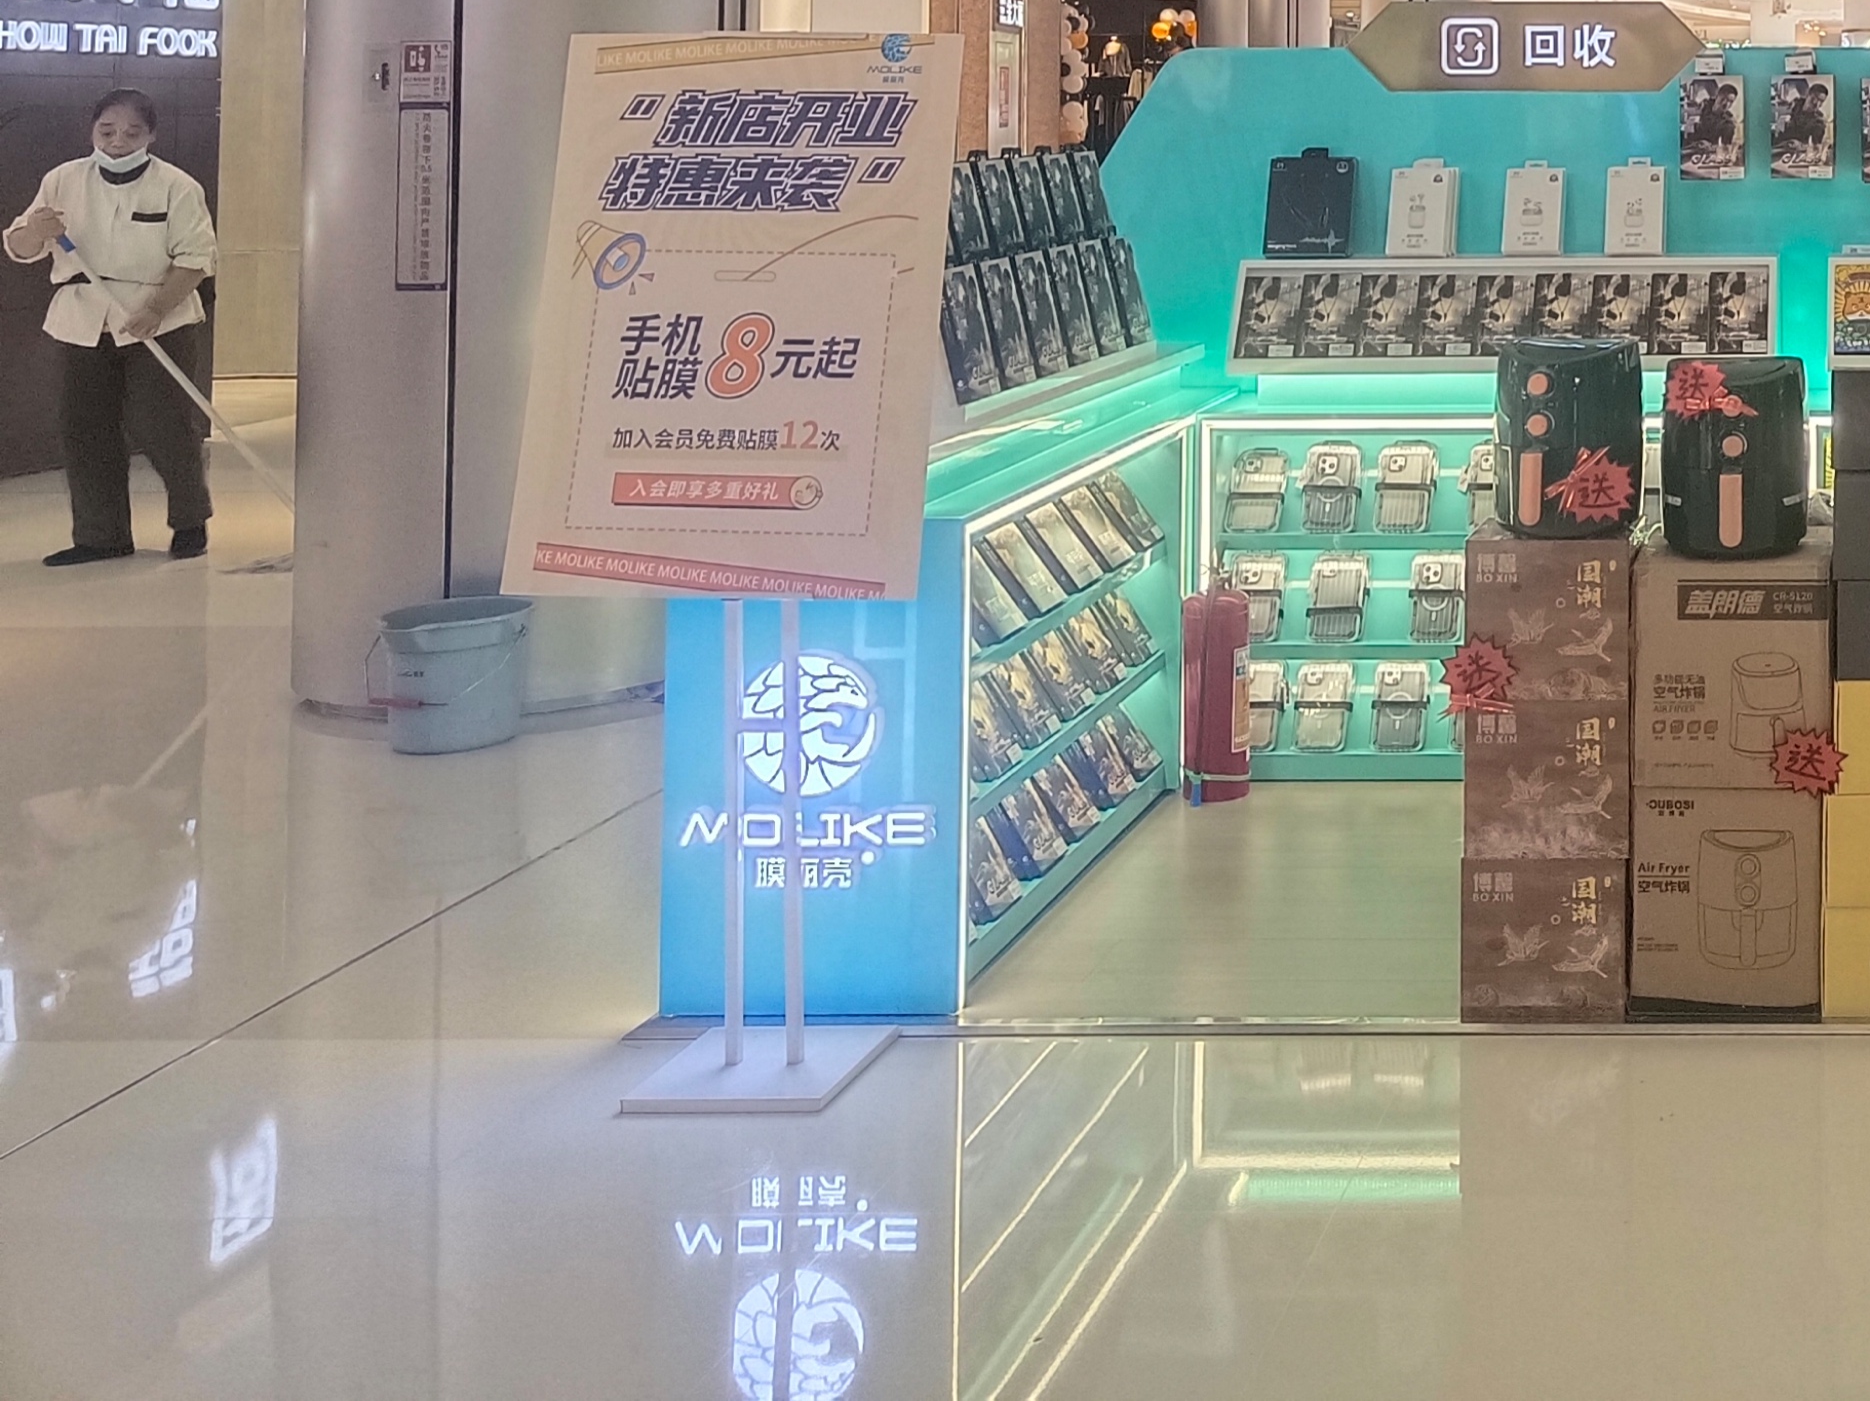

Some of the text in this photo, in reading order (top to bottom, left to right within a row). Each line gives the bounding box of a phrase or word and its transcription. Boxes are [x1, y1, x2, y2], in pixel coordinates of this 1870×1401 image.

[73, 24, 127, 54] TAI
[137, 27, 217, 57] FOOK
[625, 48, 673, 64] MOLIKE
[675, 44, 723, 60] MOLIKE
[1524, 23, 1617, 68] 回收
[620, 313, 703, 356] 手机
[705, 312, 775, 399] 8
[771, 336, 860, 379] 元起
[611, 356, 701, 400] 贴膜
[612, 420, 840, 452] 加入会员免费贴膜12次
[629, 478, 780, 501] 入会即享多重好礼
[1577, 472, 1619, 510] 送
[554, 552, 604, 571] MOLIKE
[606, 558, 656, 577] MOLIKE
[658, 564, 708, 583] MOLIKE
[710, 570, 760, 589] MOLIKE
[762, 576, 813, 596] MOLIKE
[1476, 734, 1518, 744] BO XIN
[1786, 743, 1827, 782] 送
[1638, 862, 1690, 876] Air Fryer
[1473, 893, 1514, 902] BO XIN
[1638, 880, 1690, 894] 空气炸锅
